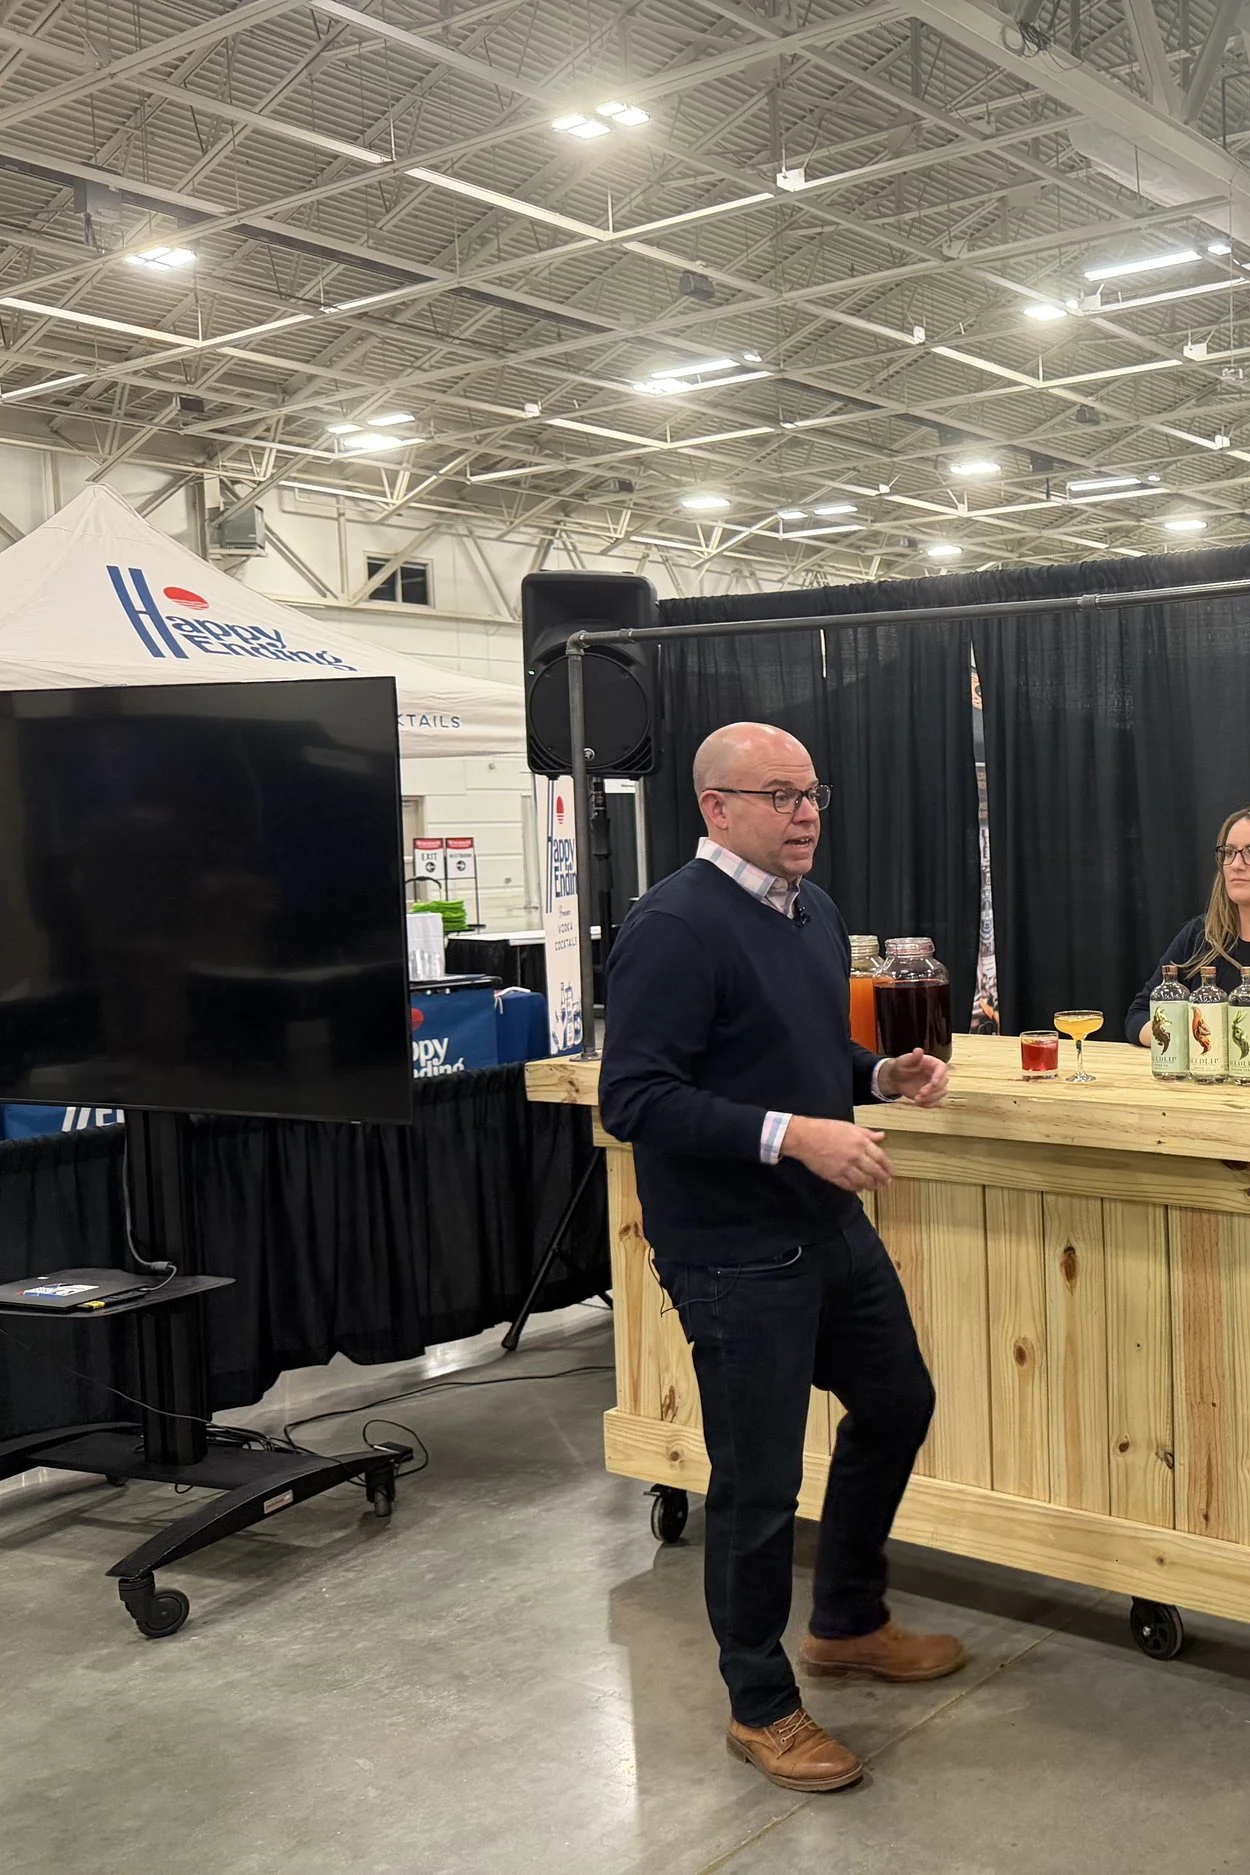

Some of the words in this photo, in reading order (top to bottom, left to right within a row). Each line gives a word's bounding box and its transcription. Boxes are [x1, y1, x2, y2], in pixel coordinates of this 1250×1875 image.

[106, 565, 285, 660] Happy
[183, 633, 358, 672] Ending
[421, 852, 438, 862] EXIT
